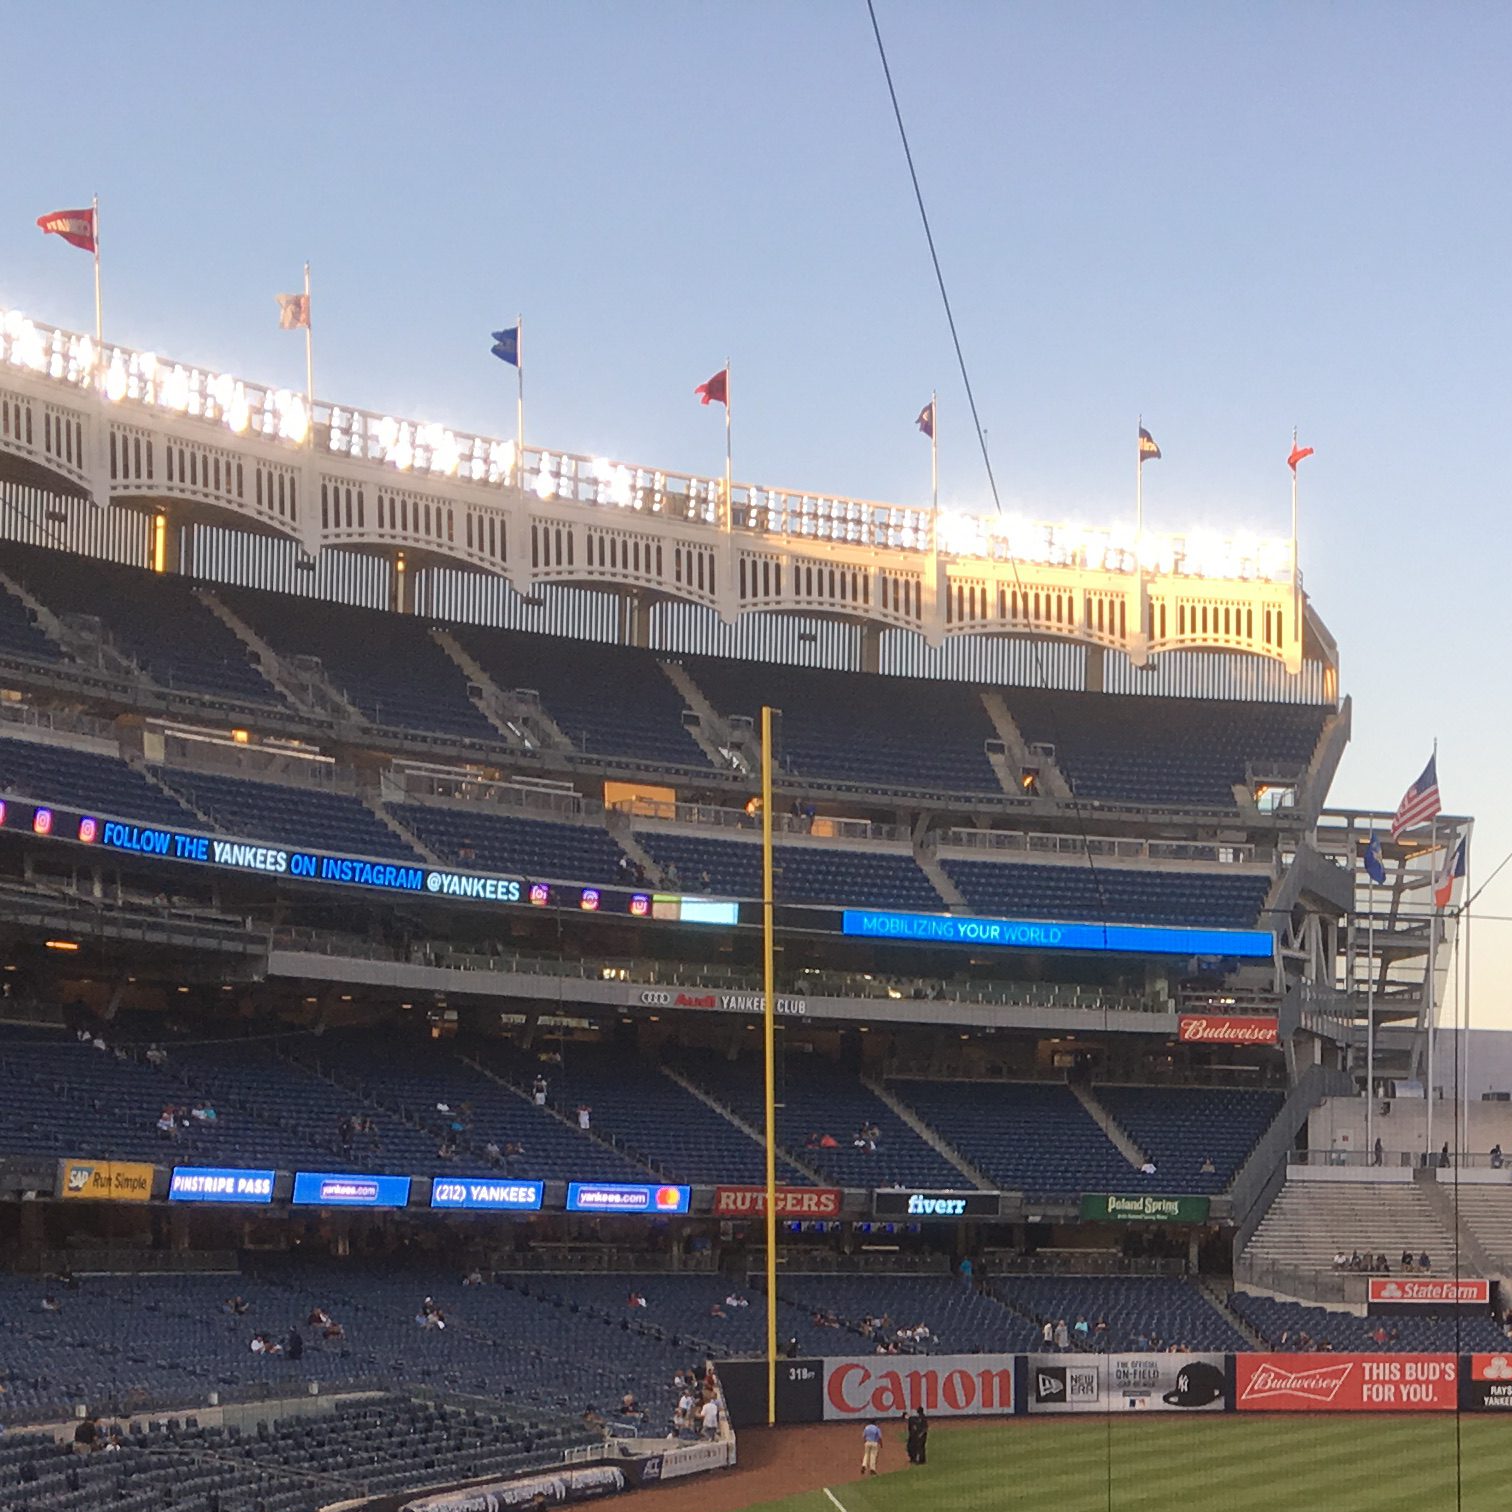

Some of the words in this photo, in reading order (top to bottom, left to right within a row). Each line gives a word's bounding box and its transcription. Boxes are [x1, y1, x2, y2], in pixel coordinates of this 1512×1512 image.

[103, 822, 170, 855] FOLLOW
[174, 835, 208, 860] THE
[213, 839, 286, 871] YANKEES
[290, 854, 316, 877] ON
[321, 857, 422, 890] INSTAGRAM
[427, 871, 519, 901] @YANKEES
[863, 915, 954, 938] MOBILIZING
[957, 923, 1000, 940] YOUR
[1004, 926, 1061, 943] WORLD
[721, 995, 766, 1011] YANKEE
[777, 999, 806, 1014] CLUB
[1181, 1019, 1278, 1040] Budweiser
[69, 1169, 90, 1188] SAP
[92, 1173, 111, 1188] Run
[114, 1174, 147, 1191] Simple
[173, 1176, 234, 1193] PINSTRIPE
[238, 1179, 271, 1194] PASS
[322, 1183, 378, 1197] yankees.com
[436, 1184, 466, 1202] (212)
[471, 1186, 536, 1203] YANKEES
[580, 1190, 646, 1203] yankees.com
[908, 1193, 965, 1214] fiverr
[1108, 1196, 1143, 1213] Poland
[1145, 1197, 1179, 1215] Spring
[1071, 1374, 1094, 1384] NEW
[1116, 1370, 1159, 1379] ON-FIELD
[1251, 1371, 1342, 1390] Budweiser
[1362, 1363, 1400, 1380] THIS
[1405, 1363, 1455, 1380] BUD'S
[827, 1363, 1012, 1413] Canon
[1071, 1385, 1094, 1395] ERA
[1362, 1384, 1395, 1401] FOR
[1400, 1384, 1438, 1402] YOU.
[1490, 1386, 1512, 1395] RAYS
